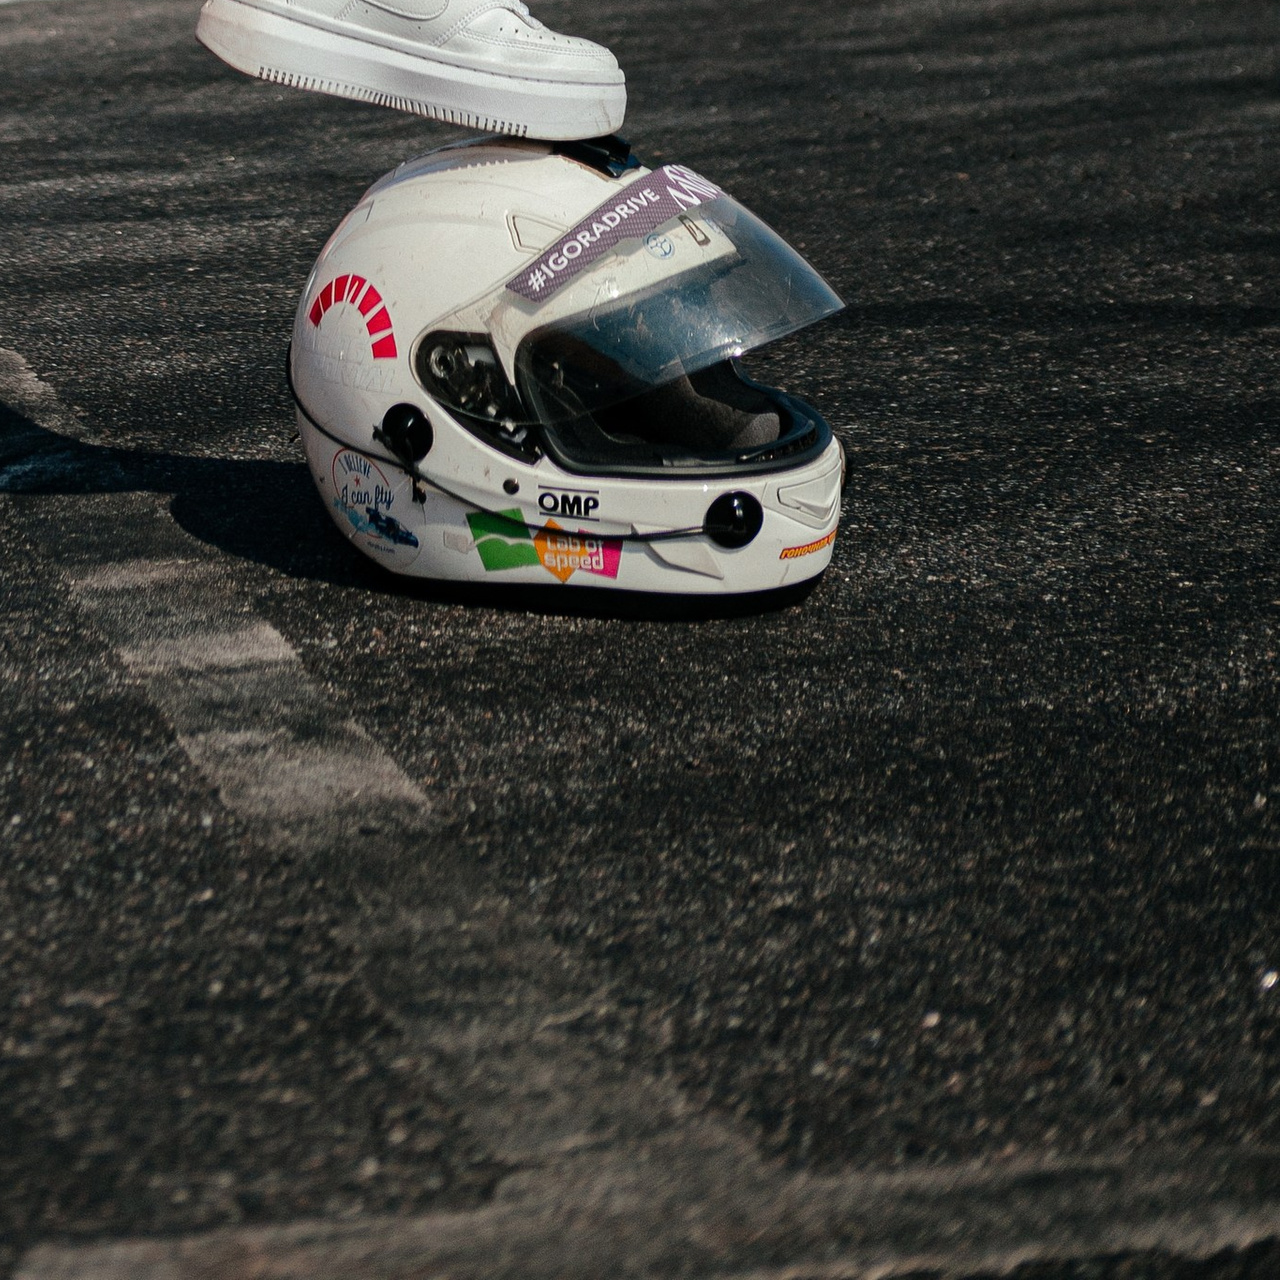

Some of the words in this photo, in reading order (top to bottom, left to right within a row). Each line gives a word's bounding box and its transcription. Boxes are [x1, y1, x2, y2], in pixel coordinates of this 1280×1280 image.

[528, 188, 660, 292] #IGORADRIVE
[343, 454, 371, 479] BELIEVE
[351, 490, 372, 505] can
[538, 492, 600, 516] OMP
[584, 539, 604, 554] of
[544, 548, 604, 572] speed
